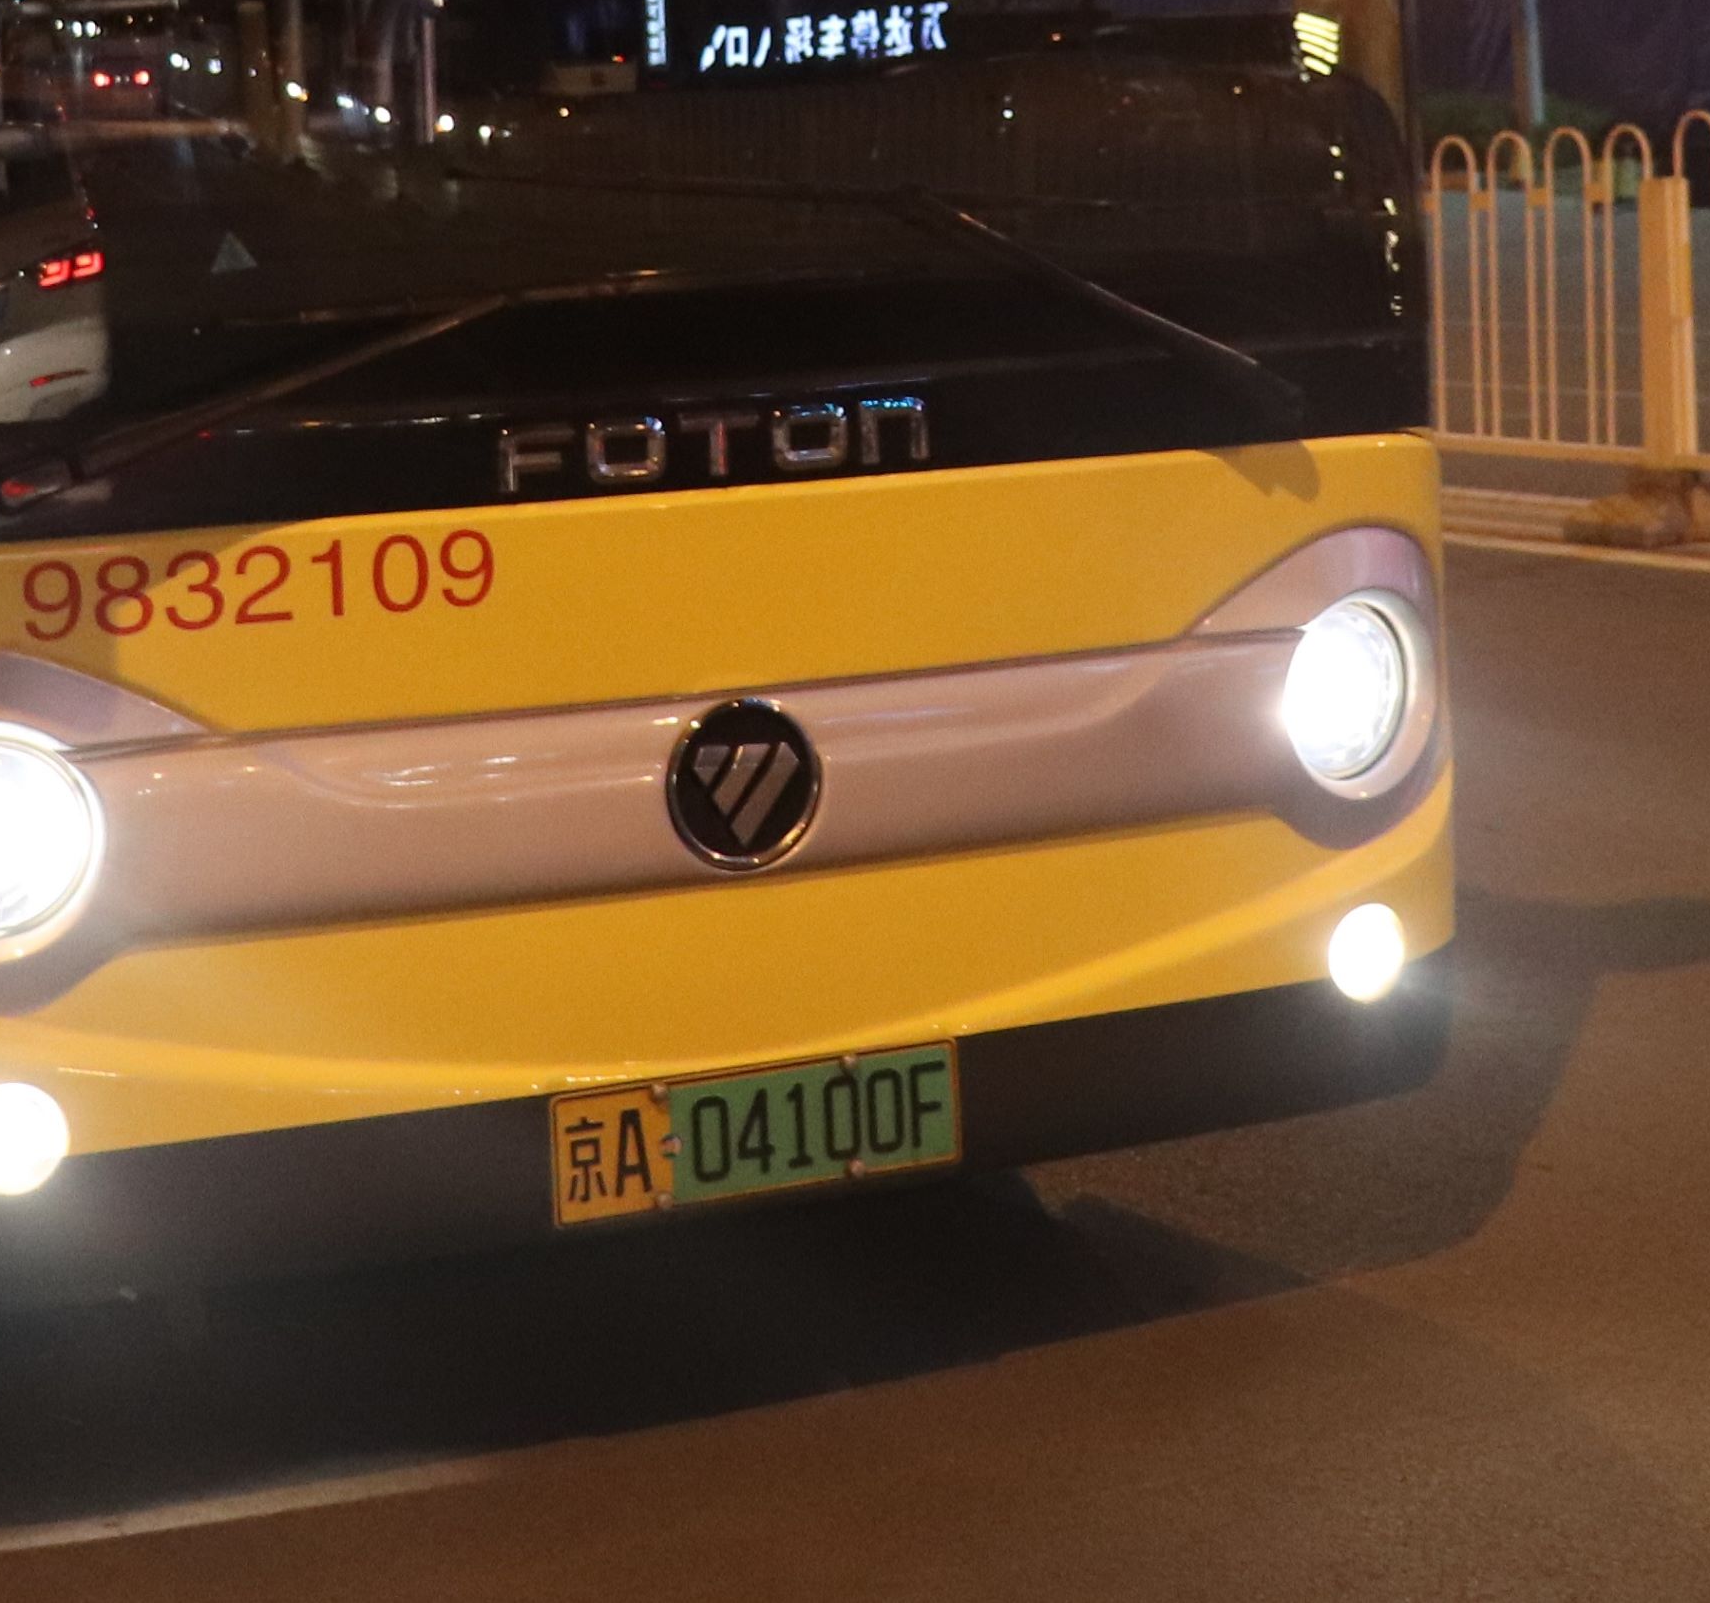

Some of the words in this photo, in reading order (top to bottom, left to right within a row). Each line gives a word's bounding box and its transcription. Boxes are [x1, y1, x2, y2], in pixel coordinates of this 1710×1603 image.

[498, 396, 930, 493] FOTON
[22, 528, 496, 642] 9832109
[564, 1107, 654, 1204] 京A
[691, 1059, 947, 1184] 04100F
